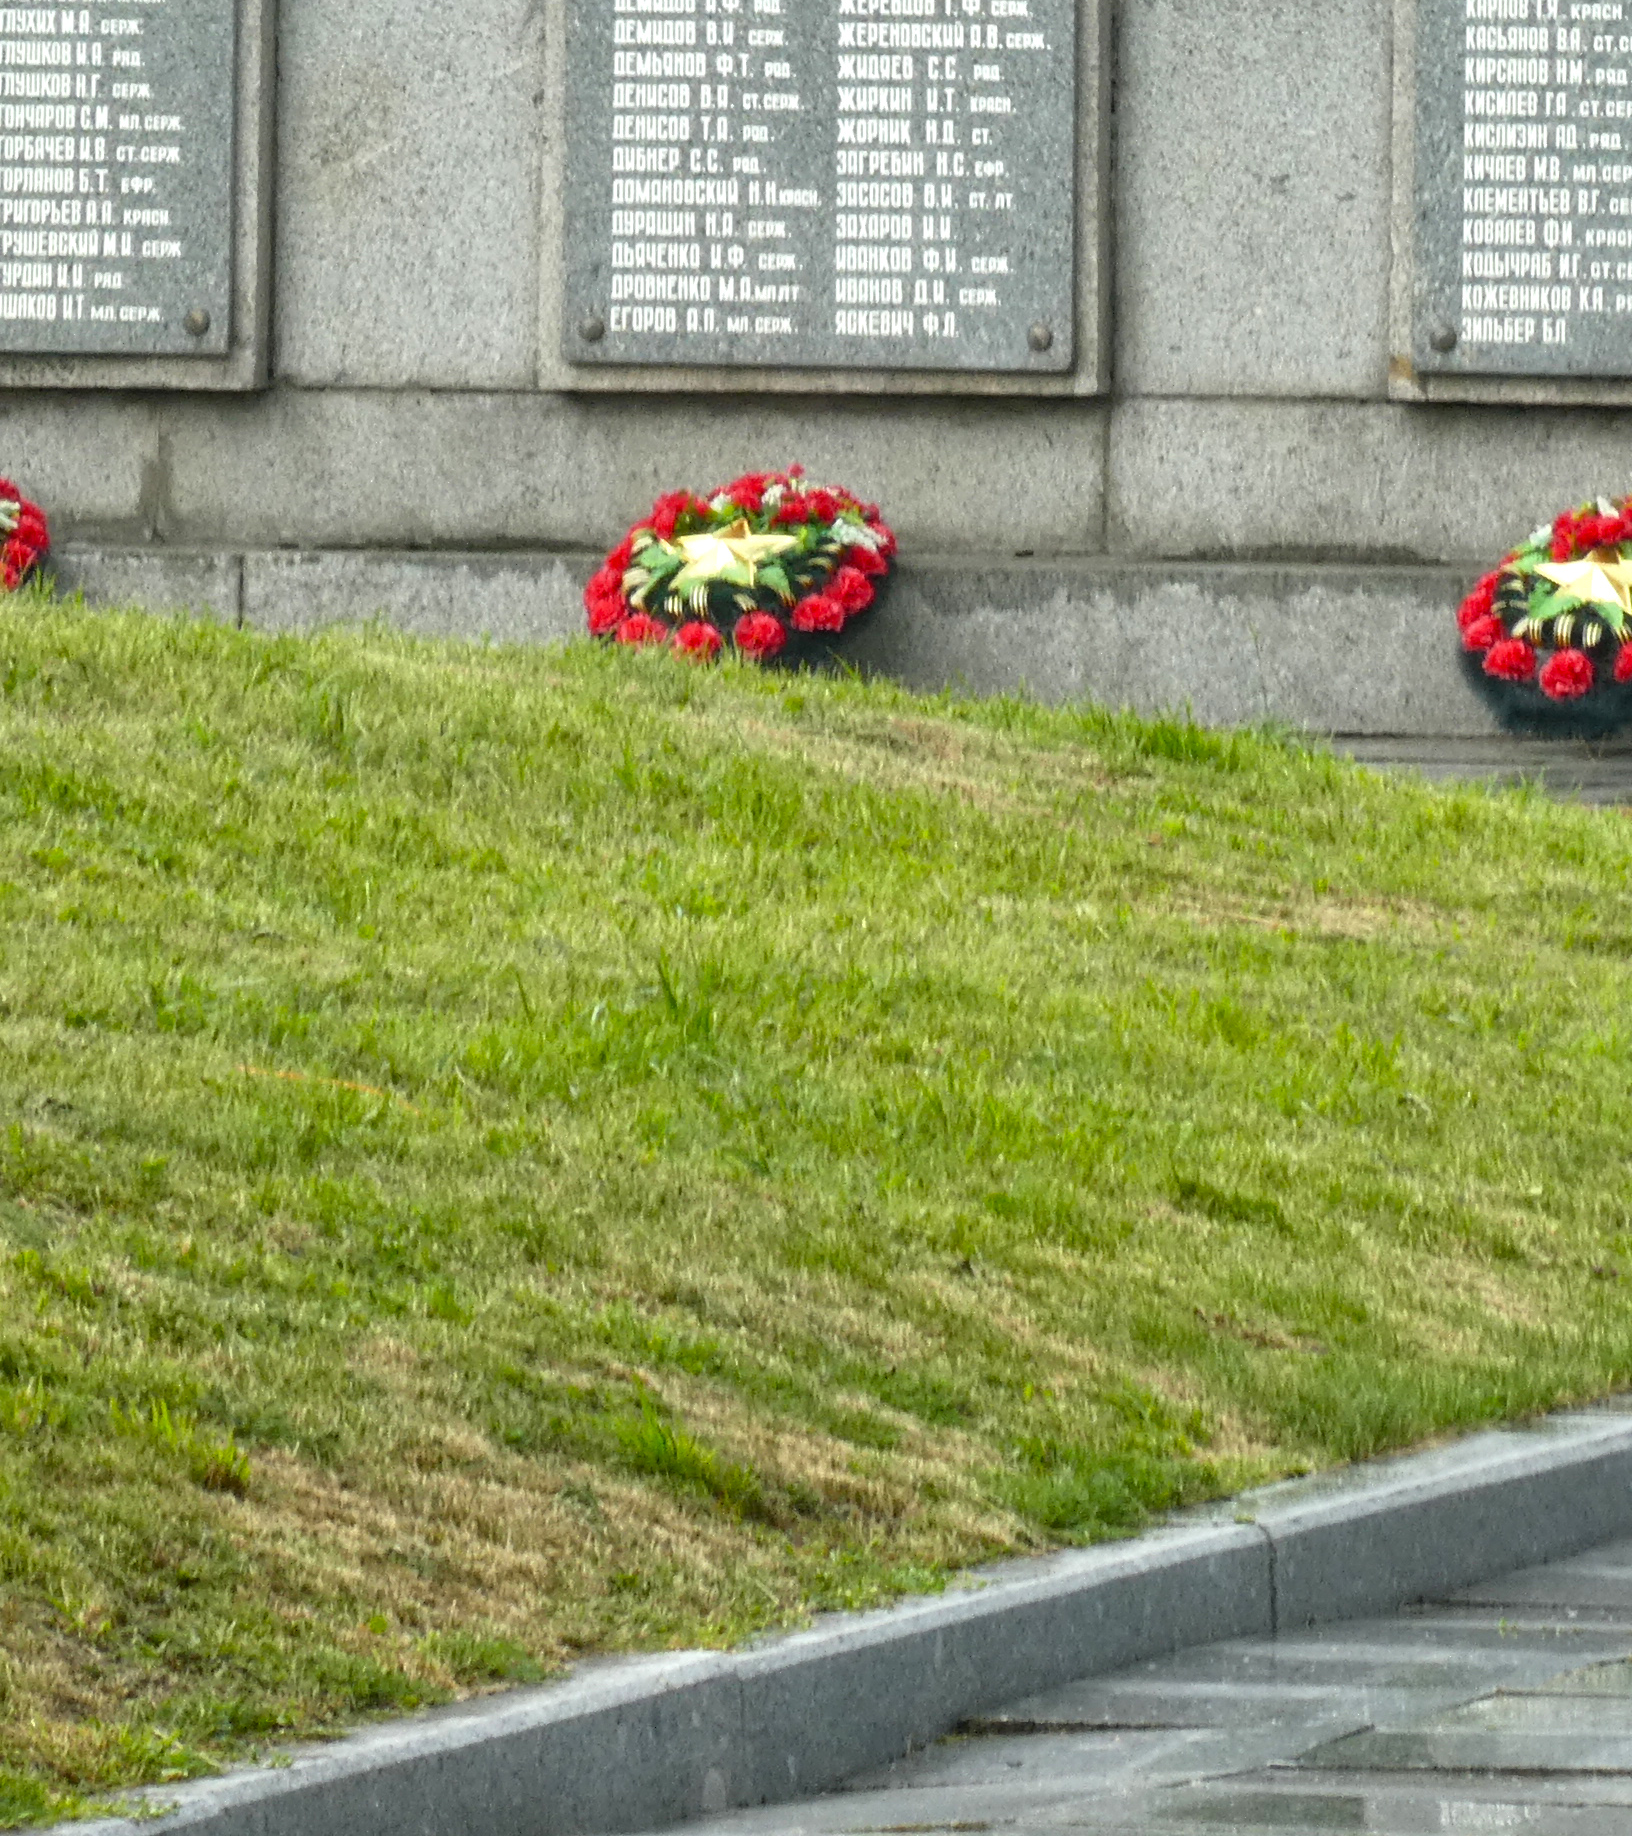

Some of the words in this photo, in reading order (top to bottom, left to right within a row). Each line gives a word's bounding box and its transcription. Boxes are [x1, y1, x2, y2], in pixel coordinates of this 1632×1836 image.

[613, 19, 697, 45] ДЕМИДОВ
[1465, 25, 1549, 51] КАСЬЯНОВ
[1464, 57, 1549, 84] КИРСАНОВ
[612, 82, 691, 109] ДЕНИСОВ
[838, 86, 913, 112] ЖИРКИН
[612, 146, 681, 172] ДИБНЕР
[836, 149, 925, 176] ЗАГРЕБИН
[1463, 154, 1527, 180] КИЧАЕВ
[1463, 186, 1571, 214] КЛЕМЕНТЬЕВ
[835, 213, 913, 240] ЗАХАРОВ
[1462, 218, 1536, 244] КОВАЛЕВ
[611, 242, 701, 269] ДЬЯЧЕНКО
[835, 277, 903, 304] ИВАНОВ
[1461, 284, 1572, 311] КОЖЕВНИКОВ
[609, 306, 677, 332] ЕГОРОВ
[1461, 316, 1535, 342] ЗИЛЬБЕР
